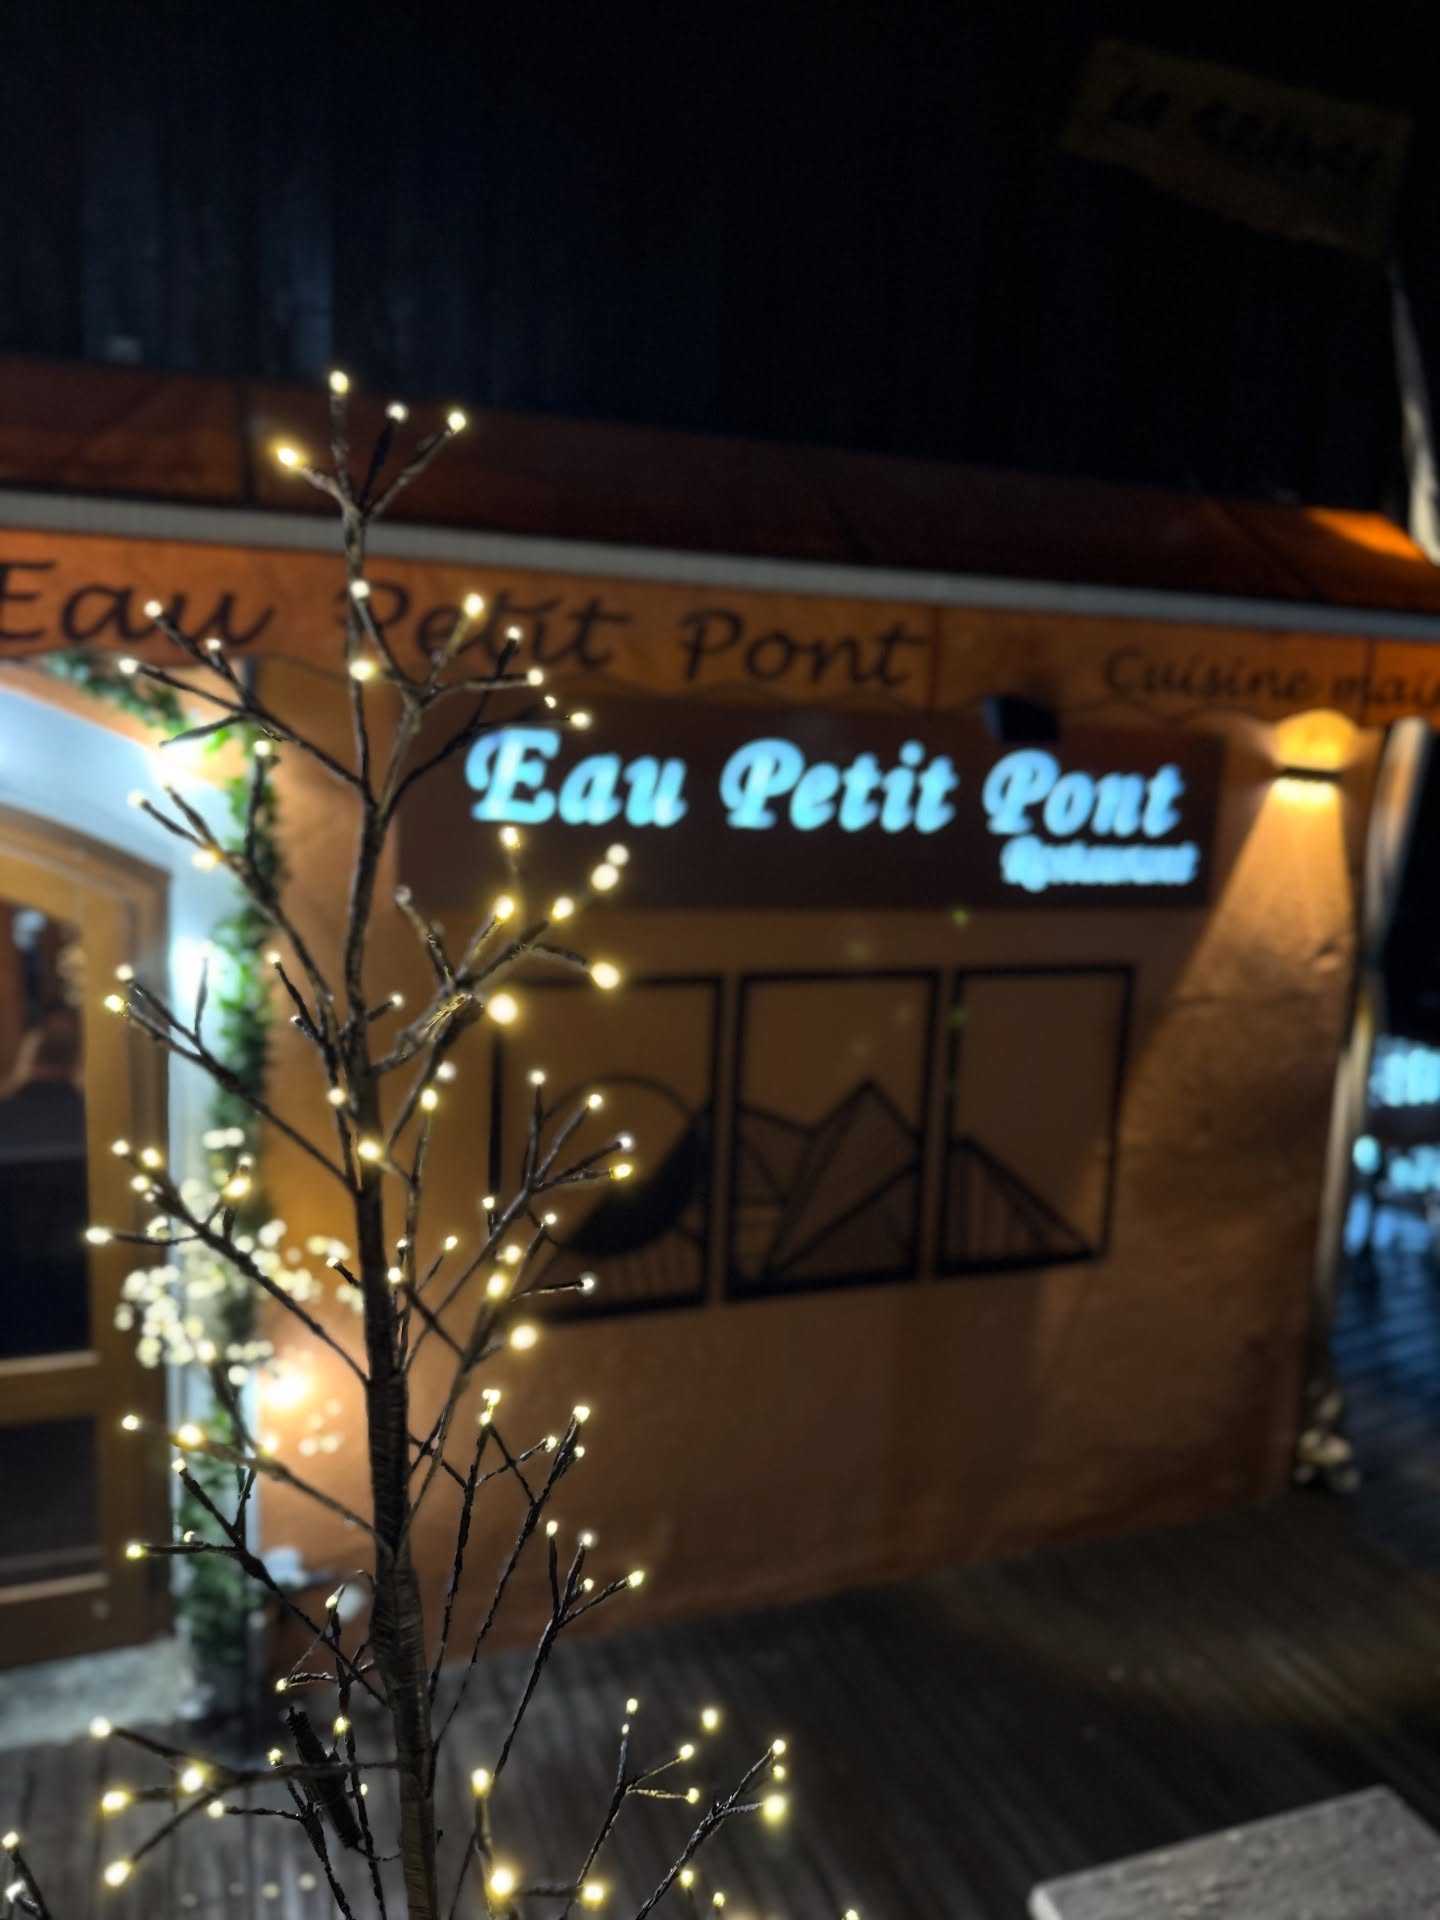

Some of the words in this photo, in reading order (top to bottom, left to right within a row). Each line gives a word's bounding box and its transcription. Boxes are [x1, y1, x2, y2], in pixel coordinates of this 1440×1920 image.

[0, 560, 275, 646] Eau
[333, 578, 633, 667] Petit
[677, 606, 930, 688] Pont
[465, 727, 687, 827] Eau
[719, 739, 957, 833] Petit
[982, 748, 1184, 839] Pont
